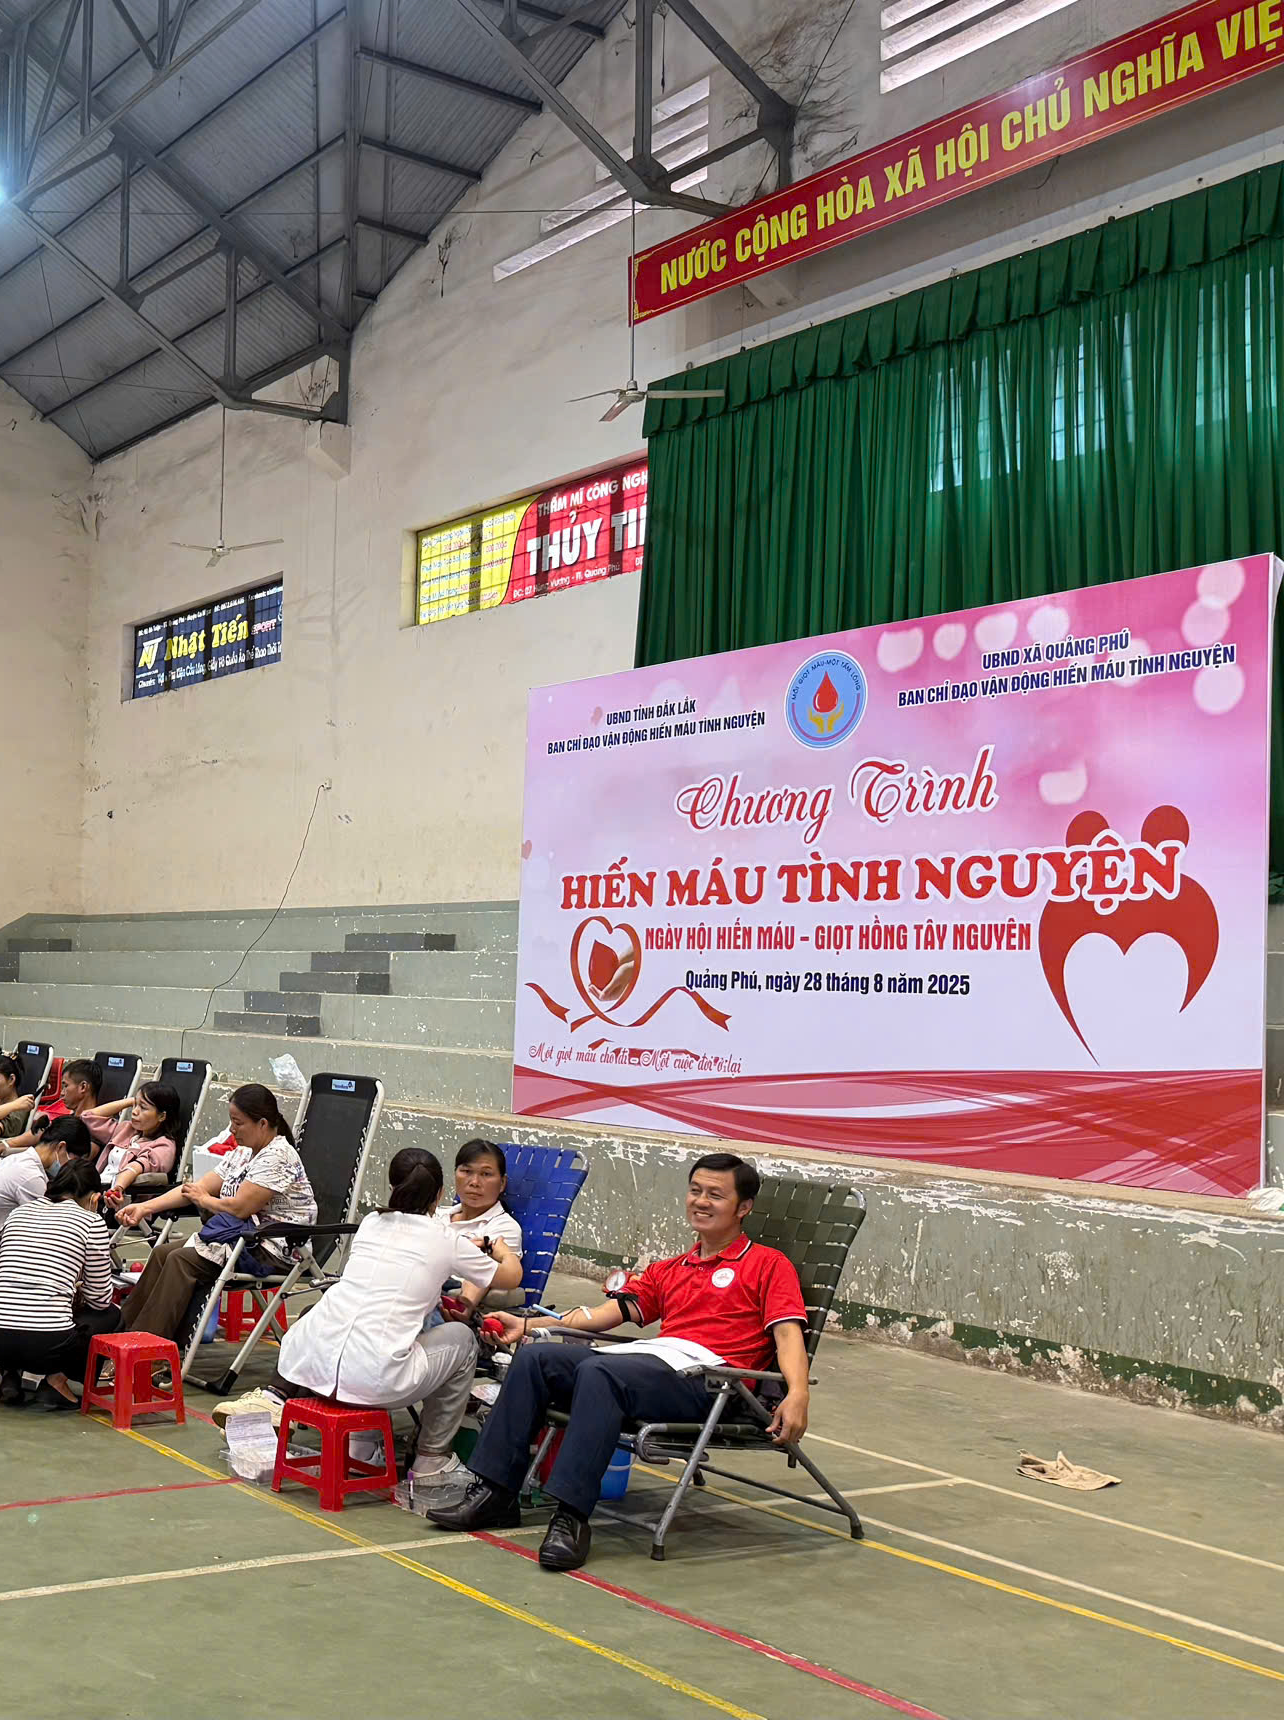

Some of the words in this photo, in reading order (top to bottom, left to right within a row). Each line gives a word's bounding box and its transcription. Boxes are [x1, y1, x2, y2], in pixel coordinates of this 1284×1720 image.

[660, 239, 727, 294] NƯỚC
[735, 204, 808, 262] CỘNG
[816, 176, 876, 230] HÒA
[884, 144, 927, 202] XÃ
[935, 123, 989, 181] HỘI
[1001, 77, 1071, 151] CHỦ
[1083, 32, 1205, 118] NGHĨA
[586, 480, 618, 501] CÔNG
[527, 509, 602, 576] THỦY
[164, 629, 206, 661] Nhật
[211, 613, 249, 648] Tiến
[983, 649, 1020, 669] UBND
[1023, 643, 1042, 664] XÃ
[1046, 636, 1095, 659] QUẢNG
[1099, 629, 1129, 653] PHÚ
[898, 688, 924, 707] BAN
[928, 681, 949, 703] CHỈ
[951, 681, 978, 701] ĐẠO
[981, 676, 1008, 698] VẬN
[1011, 672, 1050, 693] ĐỘNG
[1053, 663, 1087, 686] HIẾN
[1091, 660, 1125, 682] MÁU
[1129, 654, 1165, 676] TÌNH
[1169, 644, 1235, 670] NGUYỆN
[547, 740, 565, 755] BAN
[566, 734, 581, 752] CHỈ
[582, 736, 601, 752] ĐẠO
[602, 731, 621, 749] VẬN
[622, 728, 648, 746] ĐỘNG
[649, 722, 672, 740] HIẾN
[674, 720, 696, 737] MÁU
[723, 710, 765, 730] NGUYỆN
[606, 710, 631, 725] UBND
[656, 699, 676, 718] ĐẮK
[678, 695, 696, 714] LẮK
[676, 774, 832, 845] Chương
[851, 748, 995, 823] Trình
[560, 856, 657, 910] HIẾN
[666, 857, 767, 906] MÁU
[777, 851, 902, 903] TÌNH
[915, 834, 1180, 909] NGUYỆN
[645, 922, 683, 950] NGÀY
[686, 921, 712, 955] HỘI
[716, 917, 752, 950] HIẾN
[757, 921, 795, 950] MÁU
[815, 924, 854, 955] GIỌT
[858, 914, 908, 950] HỒNG
[914, 918, 948, 950] TÂY
[952, 917, 1031, 951] NGUYÊN
[685, 968, 728, 991] Quảng
[731, 970, 762, 992] Phú,
[765, 971, 801, 993] ngày
[803, 972, 822, 991] 28
[826, 971, 869, 994] tháng
[873, 973, 883, 993] 8
[888, 972, 924, 994] năm
[927, 974, 971, 995] 2025
[575, 1049, 596, 1063] máu
[600, 1046, 614, 1064] cho
